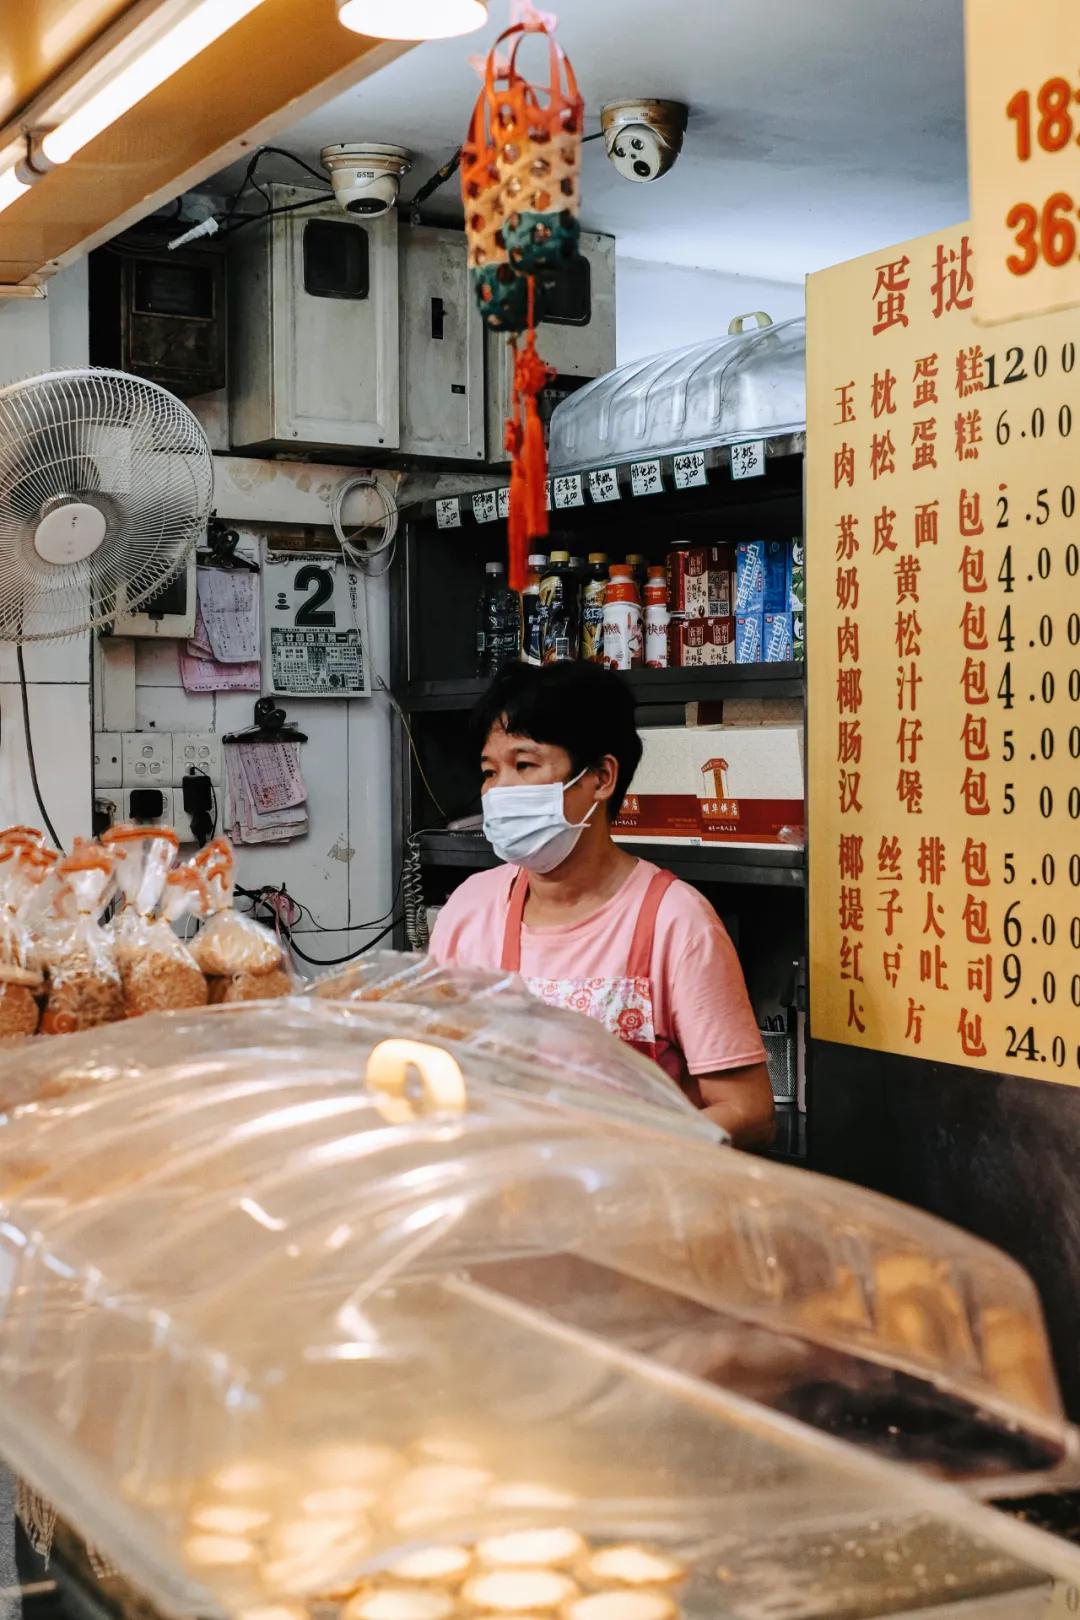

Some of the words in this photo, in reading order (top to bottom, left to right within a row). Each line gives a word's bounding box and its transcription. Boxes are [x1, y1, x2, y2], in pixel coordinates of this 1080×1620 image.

[1007, 77, 1080, 162] 18
[1006, 192, 1080, 276] 36
[833, 408, 984, 490] 肉松蛋糕
[995, 404, 1072, 446] 6.00
[294, 564, 336, 627] 2
[836, 545, 988, 610] 奶黄包
[998, 544, 1080, 593] 4.00
[837, 602, 988, 663] 肉松包
[998, 605, 1080, 652] 4.00
[836, 657, 989, 714] 椰汁包
[997, 662, 1080, 709] 4.00
[837, 714, 989, 765] 肠仔包
[1002, 726, 1080, 763] 5.00
[838, 767, 990, 816] 汉堡包
[1003, 853, 1080, 887] 5.00
[1003, 900, 1080, 949] 6.00
